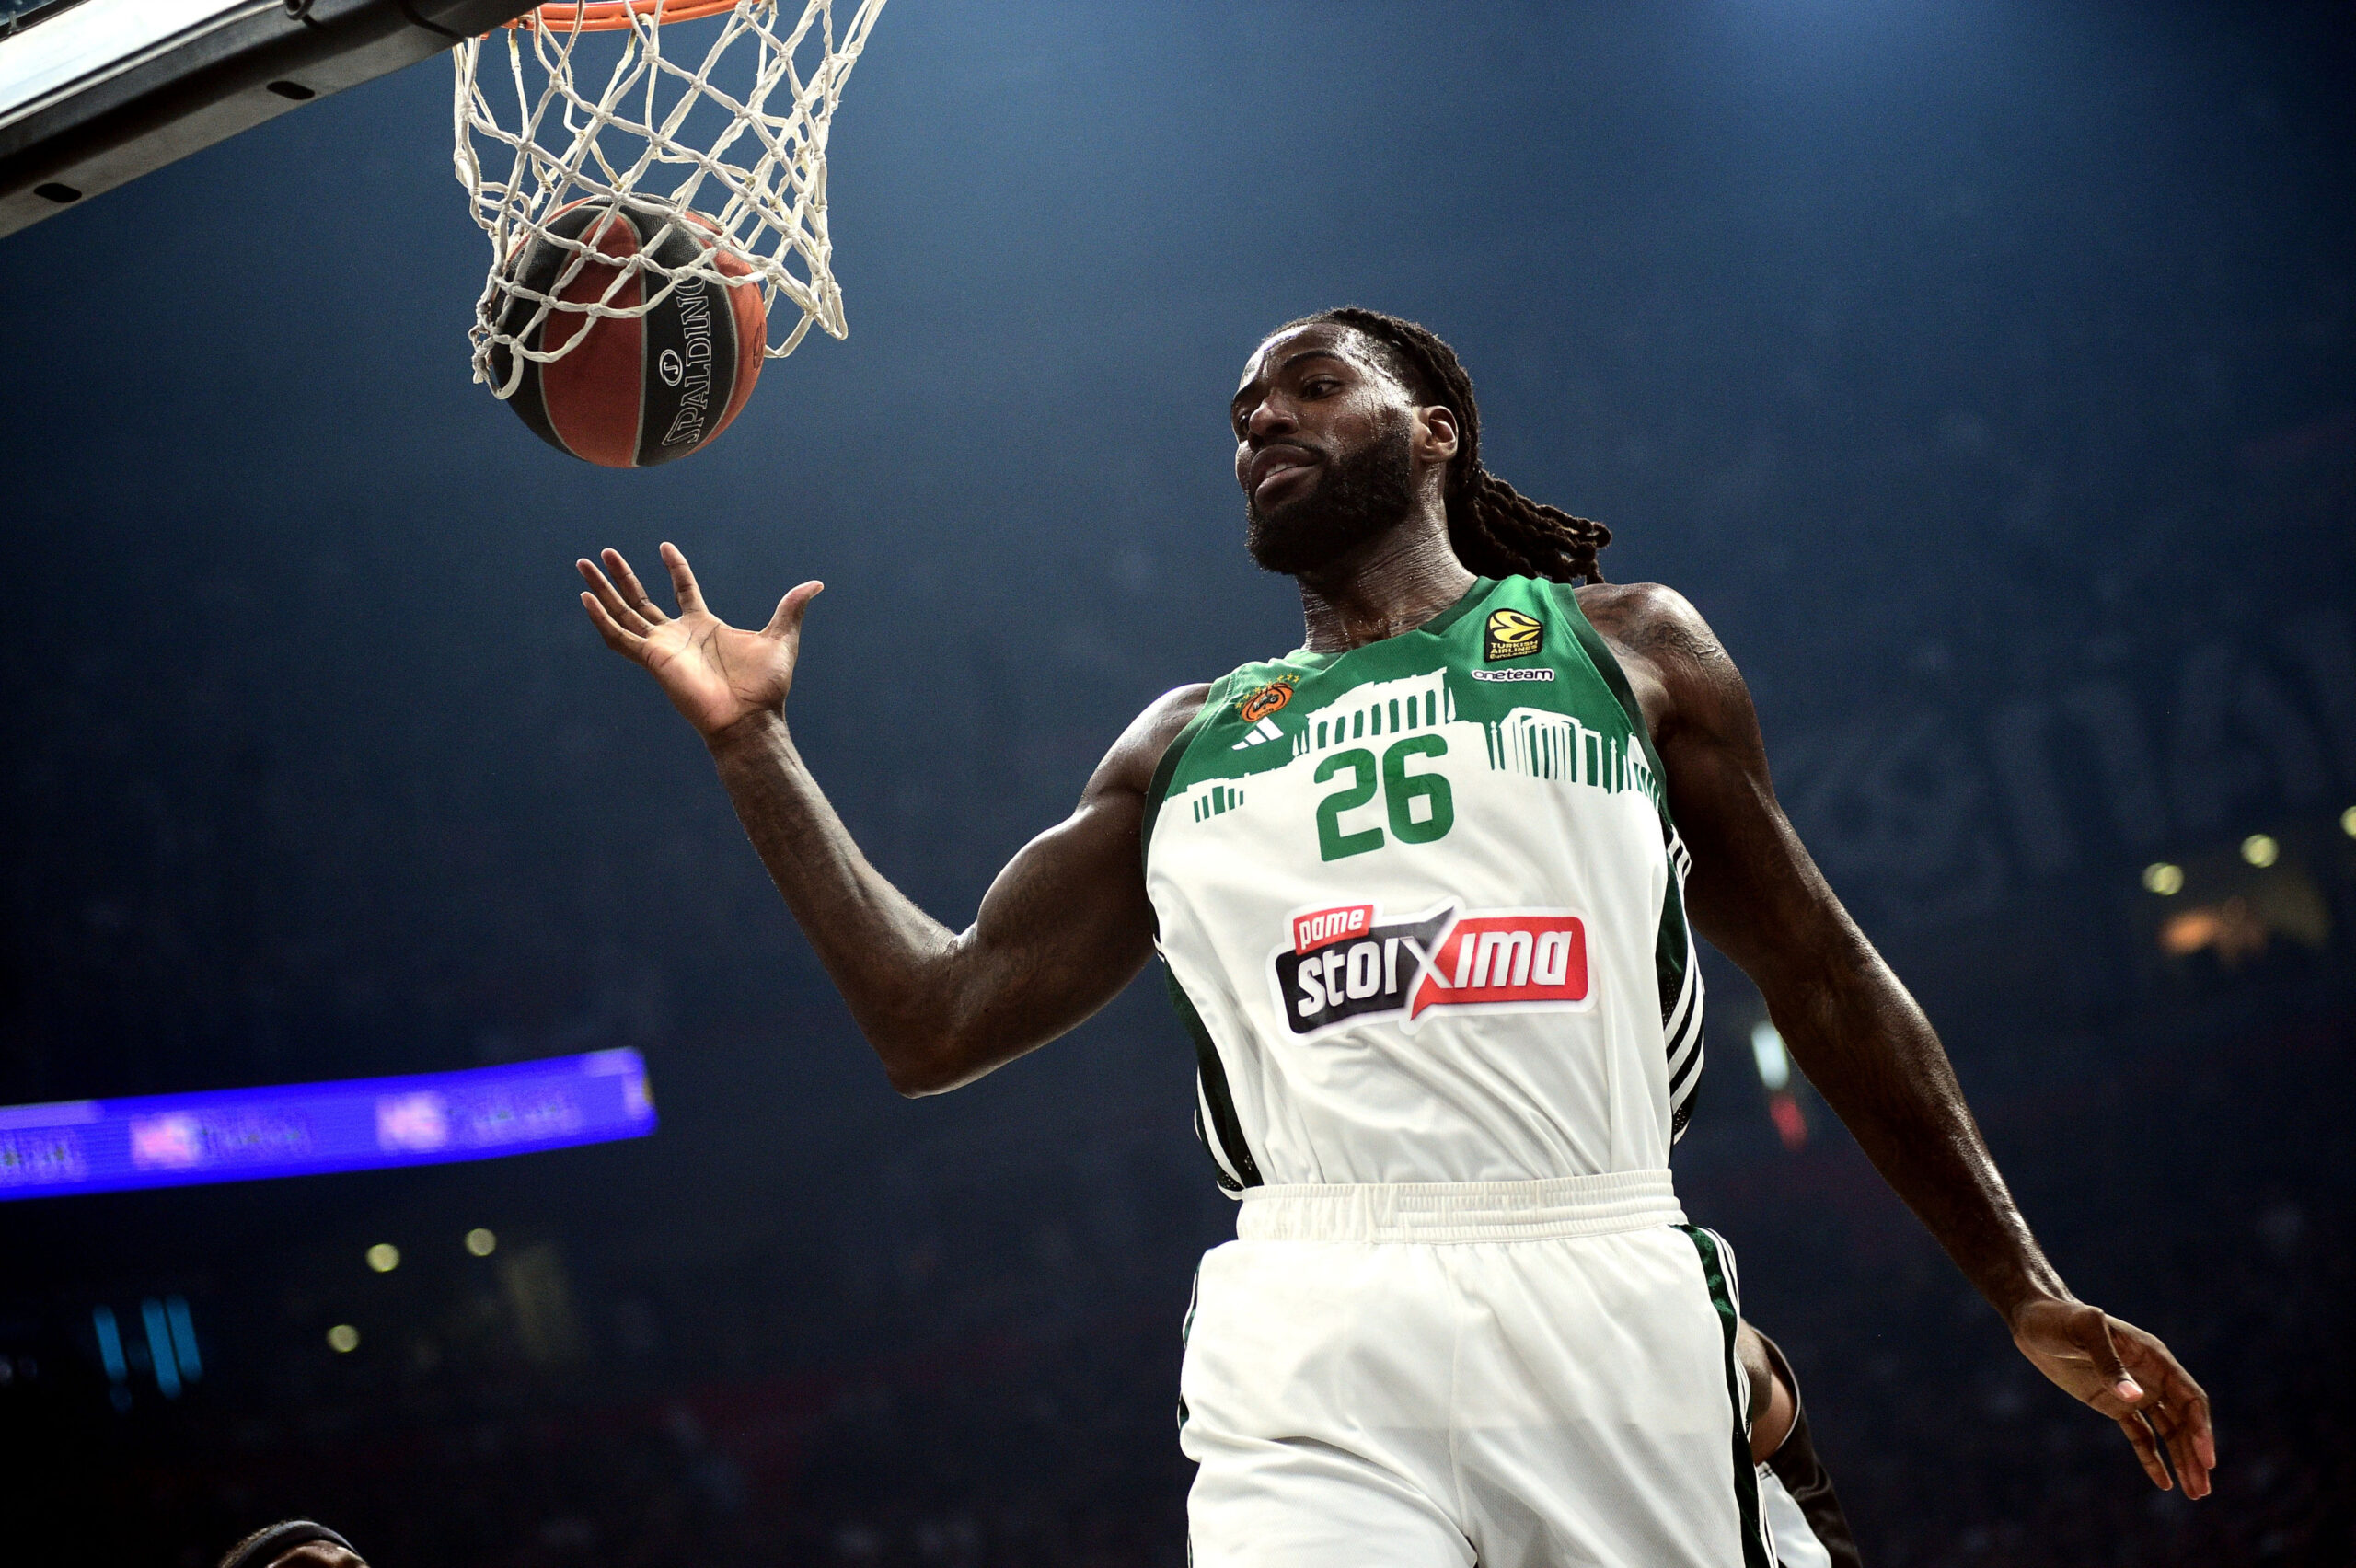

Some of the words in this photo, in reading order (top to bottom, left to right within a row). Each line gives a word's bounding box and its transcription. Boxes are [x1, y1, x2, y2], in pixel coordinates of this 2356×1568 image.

[1490, 644, 1538, 654] AIRLINES
[1491, 640, 1538, 649] TURKISH
[1473, 670, 1553, 680] oneteam
[1313, 733, 1454, 862] 26
[1299, 907, 1365, 950] pame
